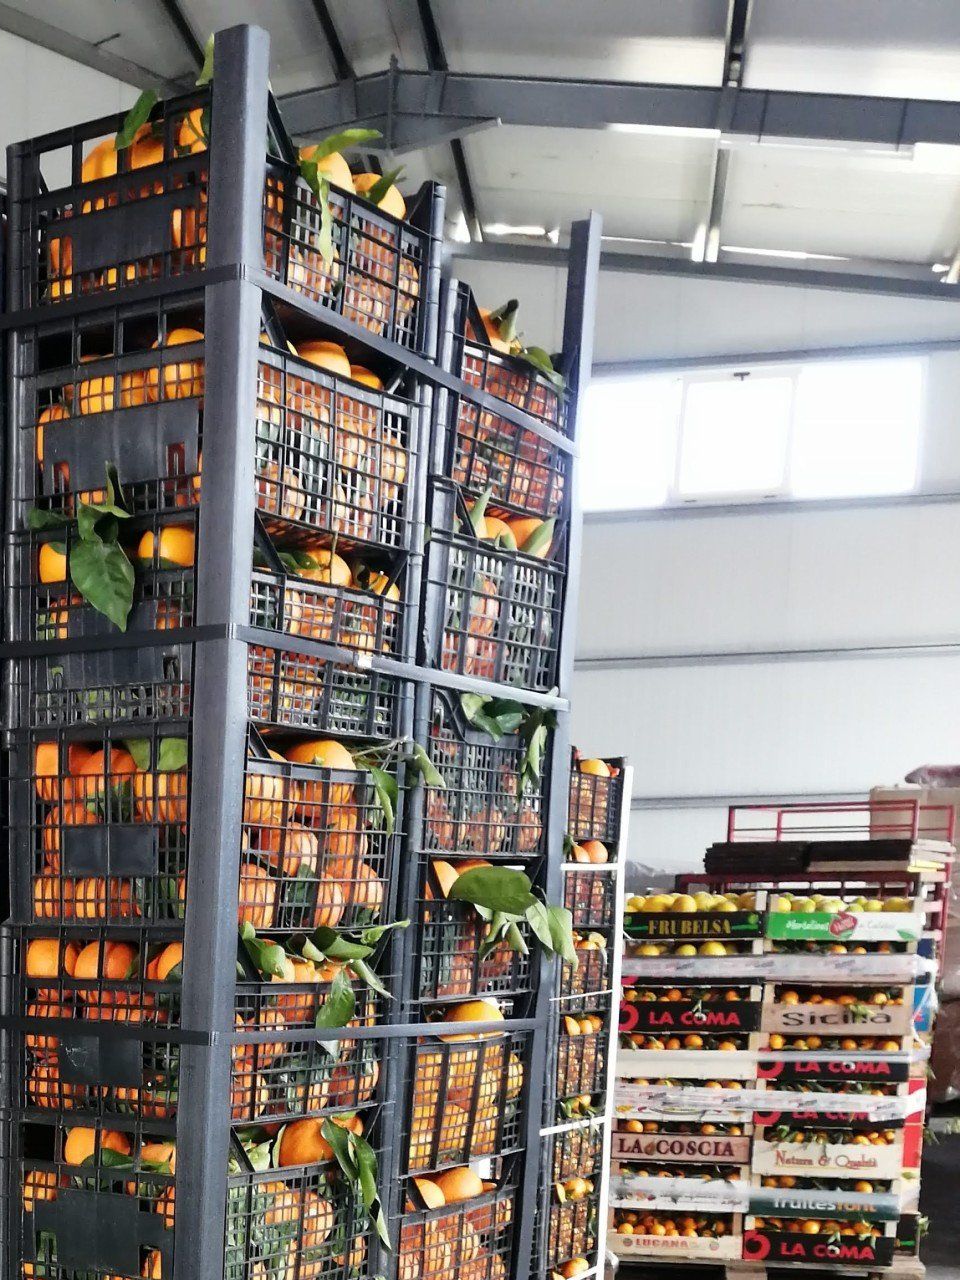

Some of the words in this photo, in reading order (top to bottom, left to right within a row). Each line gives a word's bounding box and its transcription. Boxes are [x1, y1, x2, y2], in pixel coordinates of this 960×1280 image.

[648, 918, 732, 935] FRUBELSA
[649, 1011, 674, 1025] LA
[680, 1011, 741, 1026] COMA
[794, 1061, 821, 1073] LA
[828, 1061, 890, 1075] COMA
[618, 1138, 644, 1154] LA
[656, 1139, 736, 1157] COSCIA
[775, 1150, 814, 1167] Natura
[780, 1242, 806, 1257] LA
[813, 1243, 875, 1260] COMA
